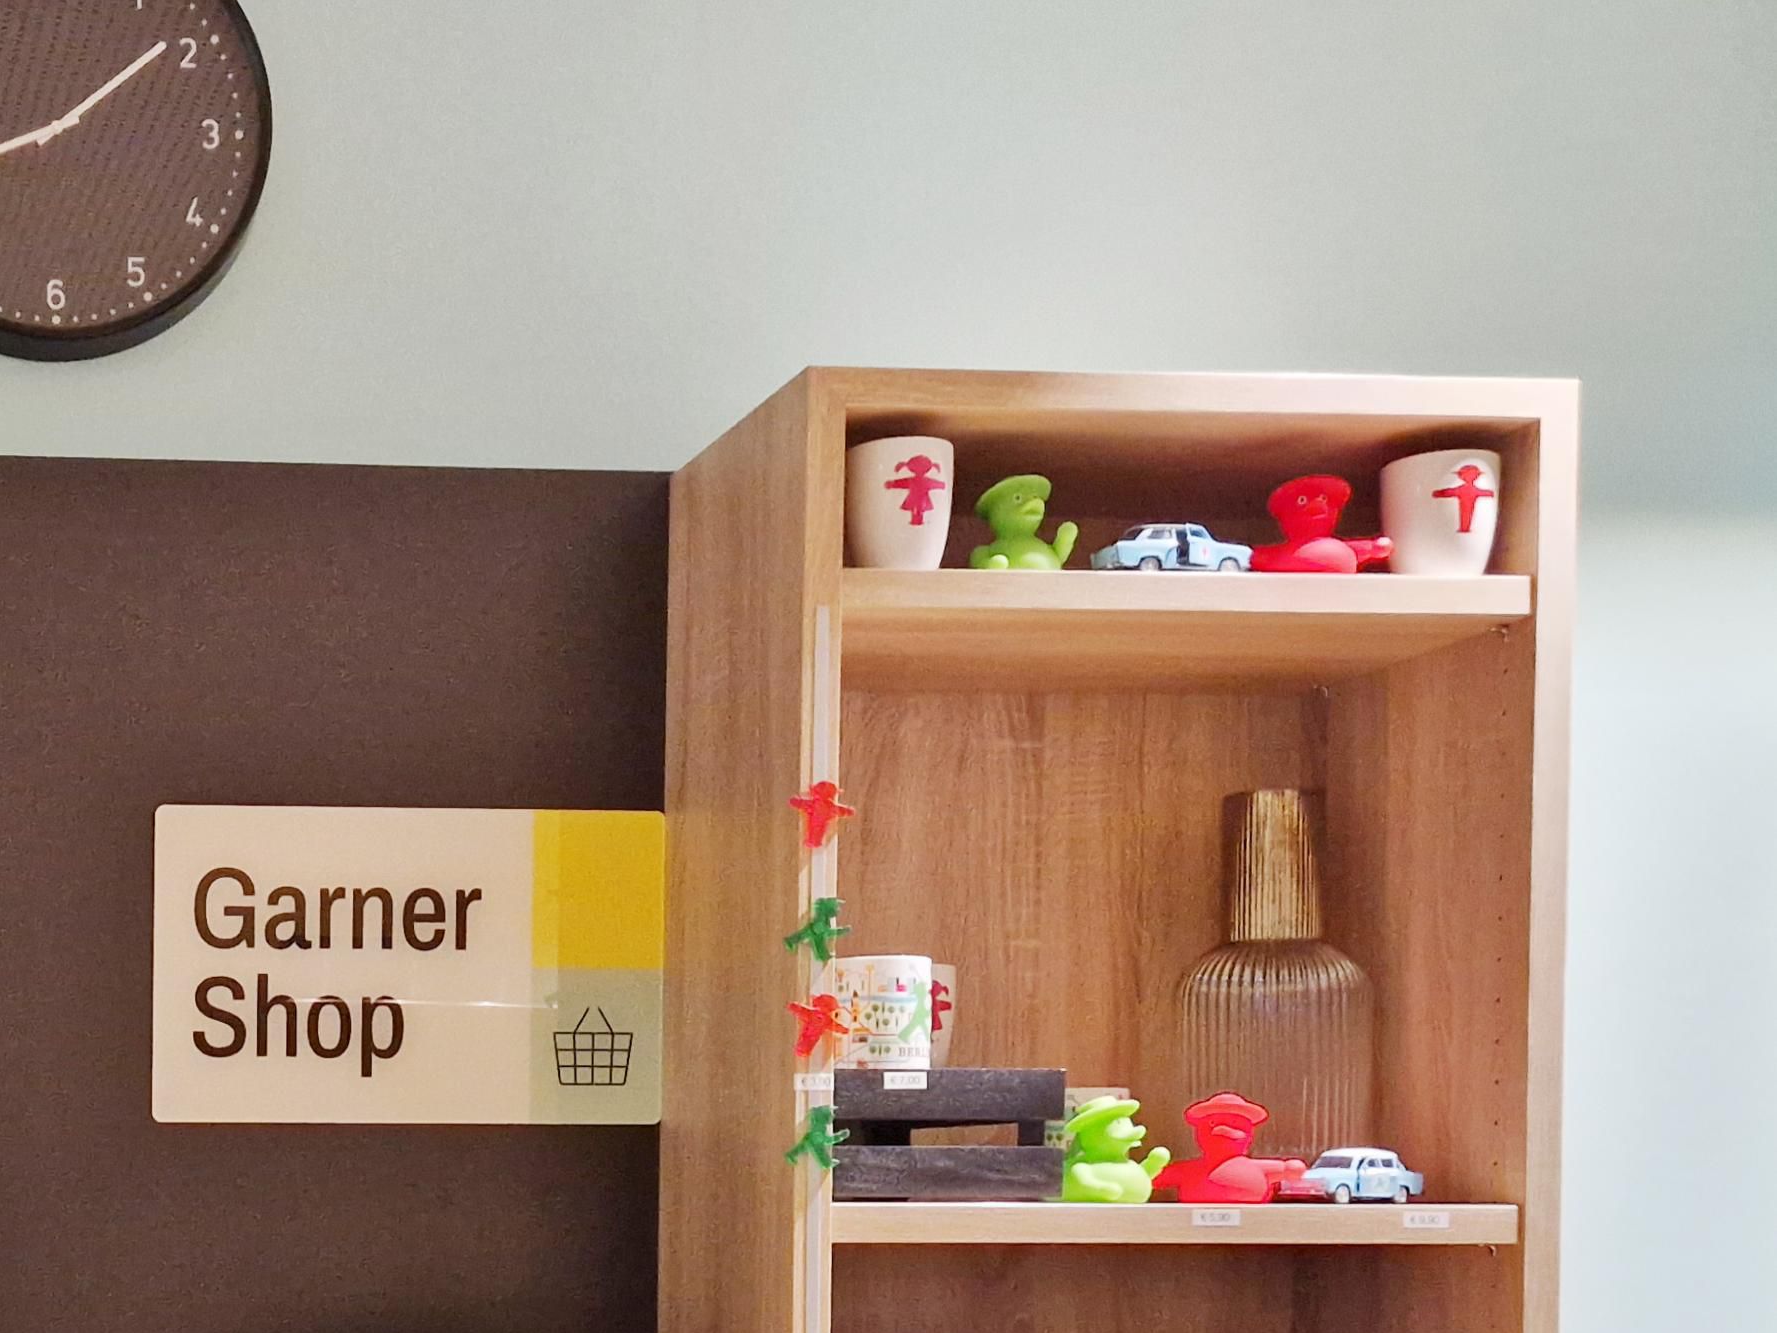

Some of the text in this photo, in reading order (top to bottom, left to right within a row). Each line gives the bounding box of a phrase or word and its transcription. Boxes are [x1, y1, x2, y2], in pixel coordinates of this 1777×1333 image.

[179, 37, 198, 69] 2
[202, 119, 221, 149] 3
[185, 197, 204, 227] 4
[127, 257, 146, 286] 5
[47, 279, 66, 309] 6
[194, 867, 482, 951] Garner
[192, 974, 404, 1078] Shop
